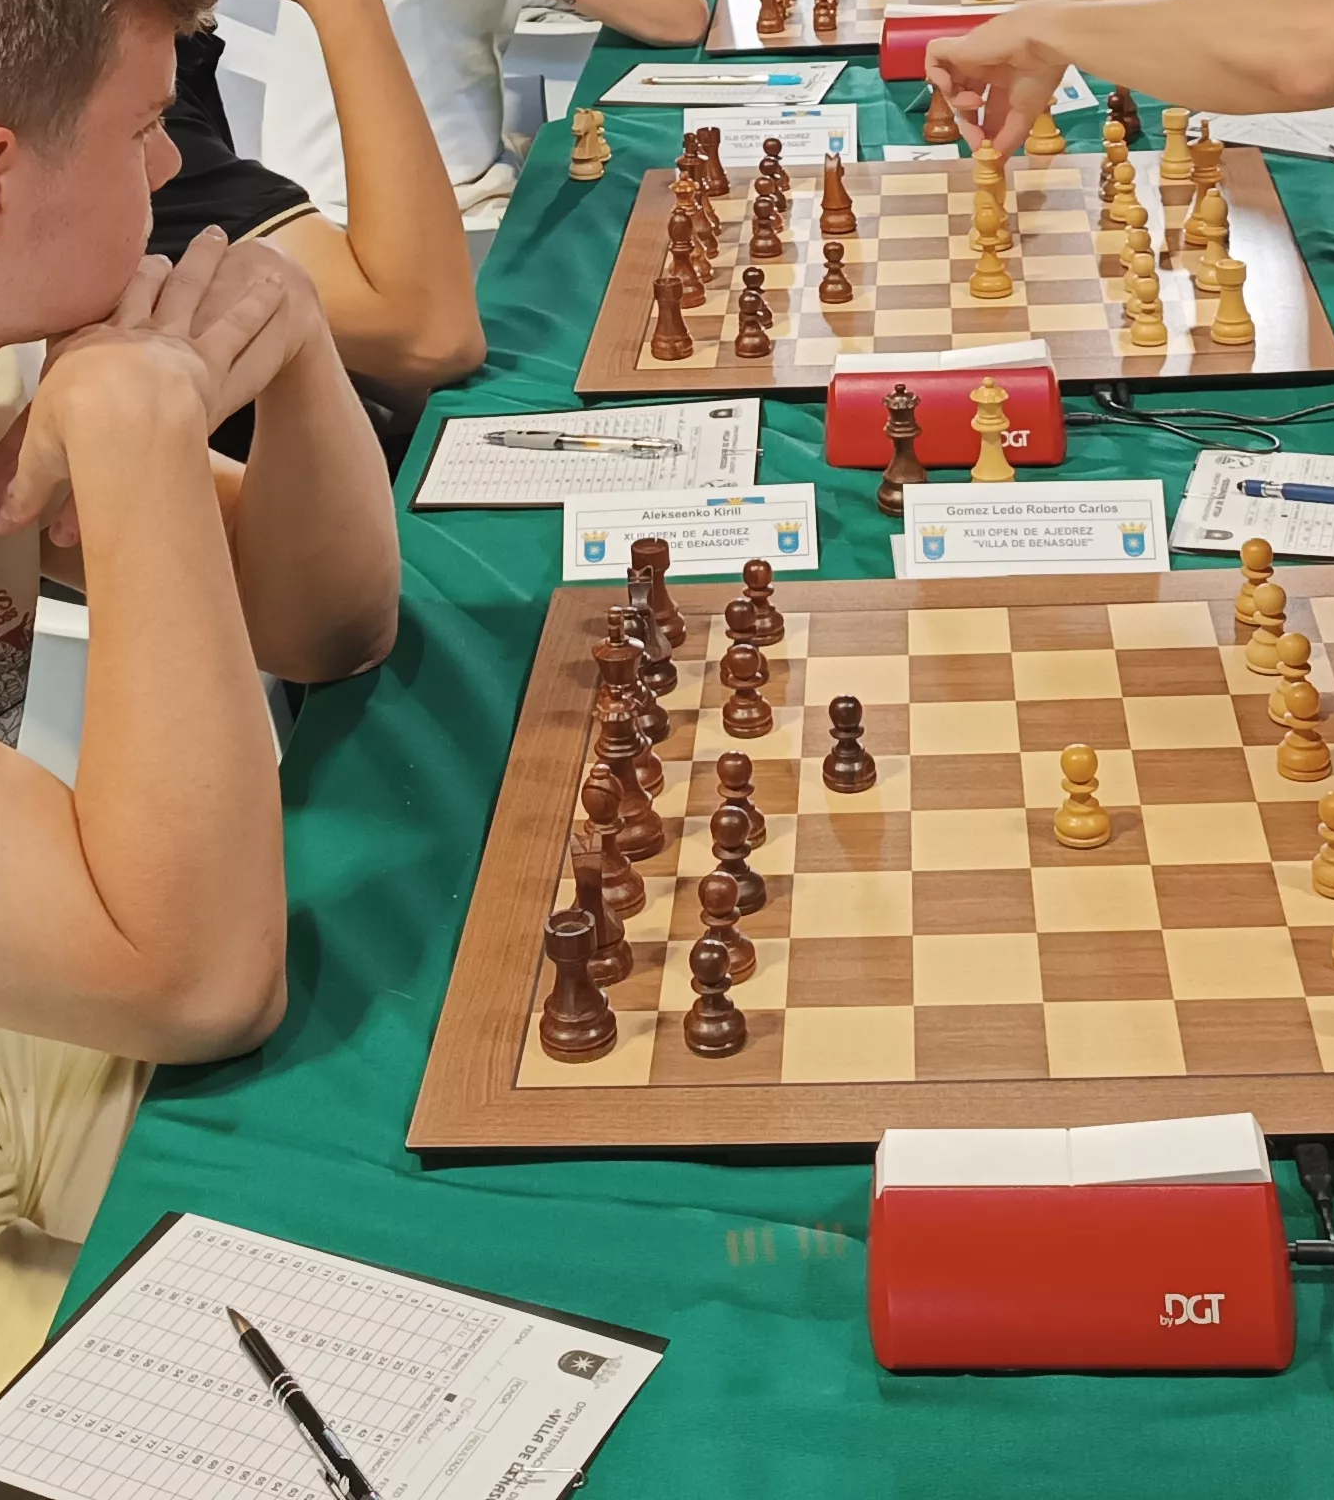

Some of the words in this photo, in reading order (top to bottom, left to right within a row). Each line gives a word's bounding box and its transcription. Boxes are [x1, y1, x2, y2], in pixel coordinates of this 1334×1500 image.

[642, 508, 710, 520] Alekseenko
[714, 507, 742, 517] Kirill
[946, 506, 989, 517] Gomez
[992, 505, 1023, 516] Ledo
[1026, 504, 1075, 515] Roberto
[1079, 503, 1119, 514] Carlos
[682, 530, 696, 538] DE
[702, 527, 750, 537] AJEDREZ
[988, 528, 1018, 537] OPEN
[1024, 528, 1039, 536] DE
[1044, 527, 1094, 536] AJEDREZ
[670, 541, 684, 549] DE
[1011, 539, 1027, 548] DE
[1164, 1293, 1225, 1326] DGT
[1159, 1313, 1174, 1328] by
[564, 1401, 587, 1425] OPEN
[518, 1445, 537, 1460] DE
